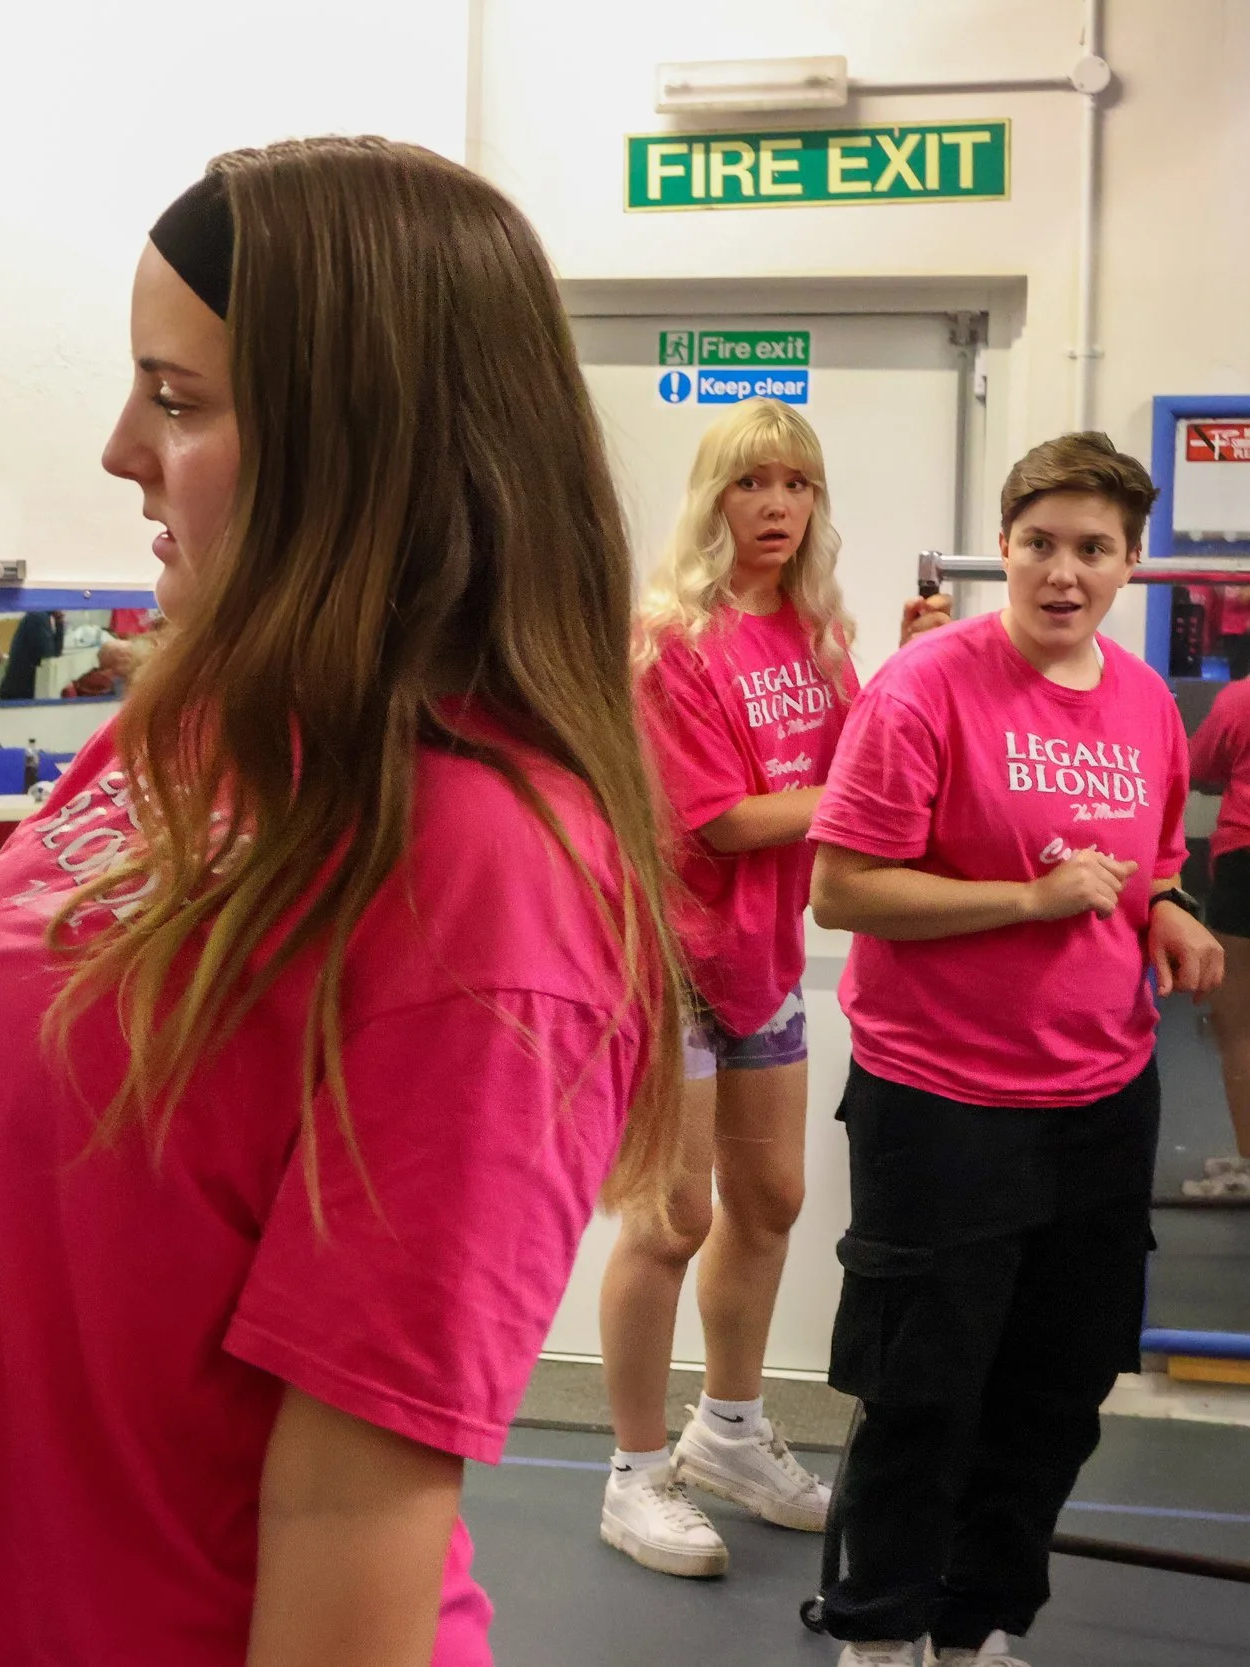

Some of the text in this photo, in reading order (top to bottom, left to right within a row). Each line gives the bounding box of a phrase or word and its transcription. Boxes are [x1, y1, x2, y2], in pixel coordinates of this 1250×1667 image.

[646, 131, 991, 199] FIRE EXIT
[701, 336, 806, 359] Fire exit
[700, 376, 806, 399] Keep clear
[738, 659, 822, 699] LEGALL
[1004, 731, 1141, 774] LEGALLY
[1007, 761, 1150, 807] BLONDE
